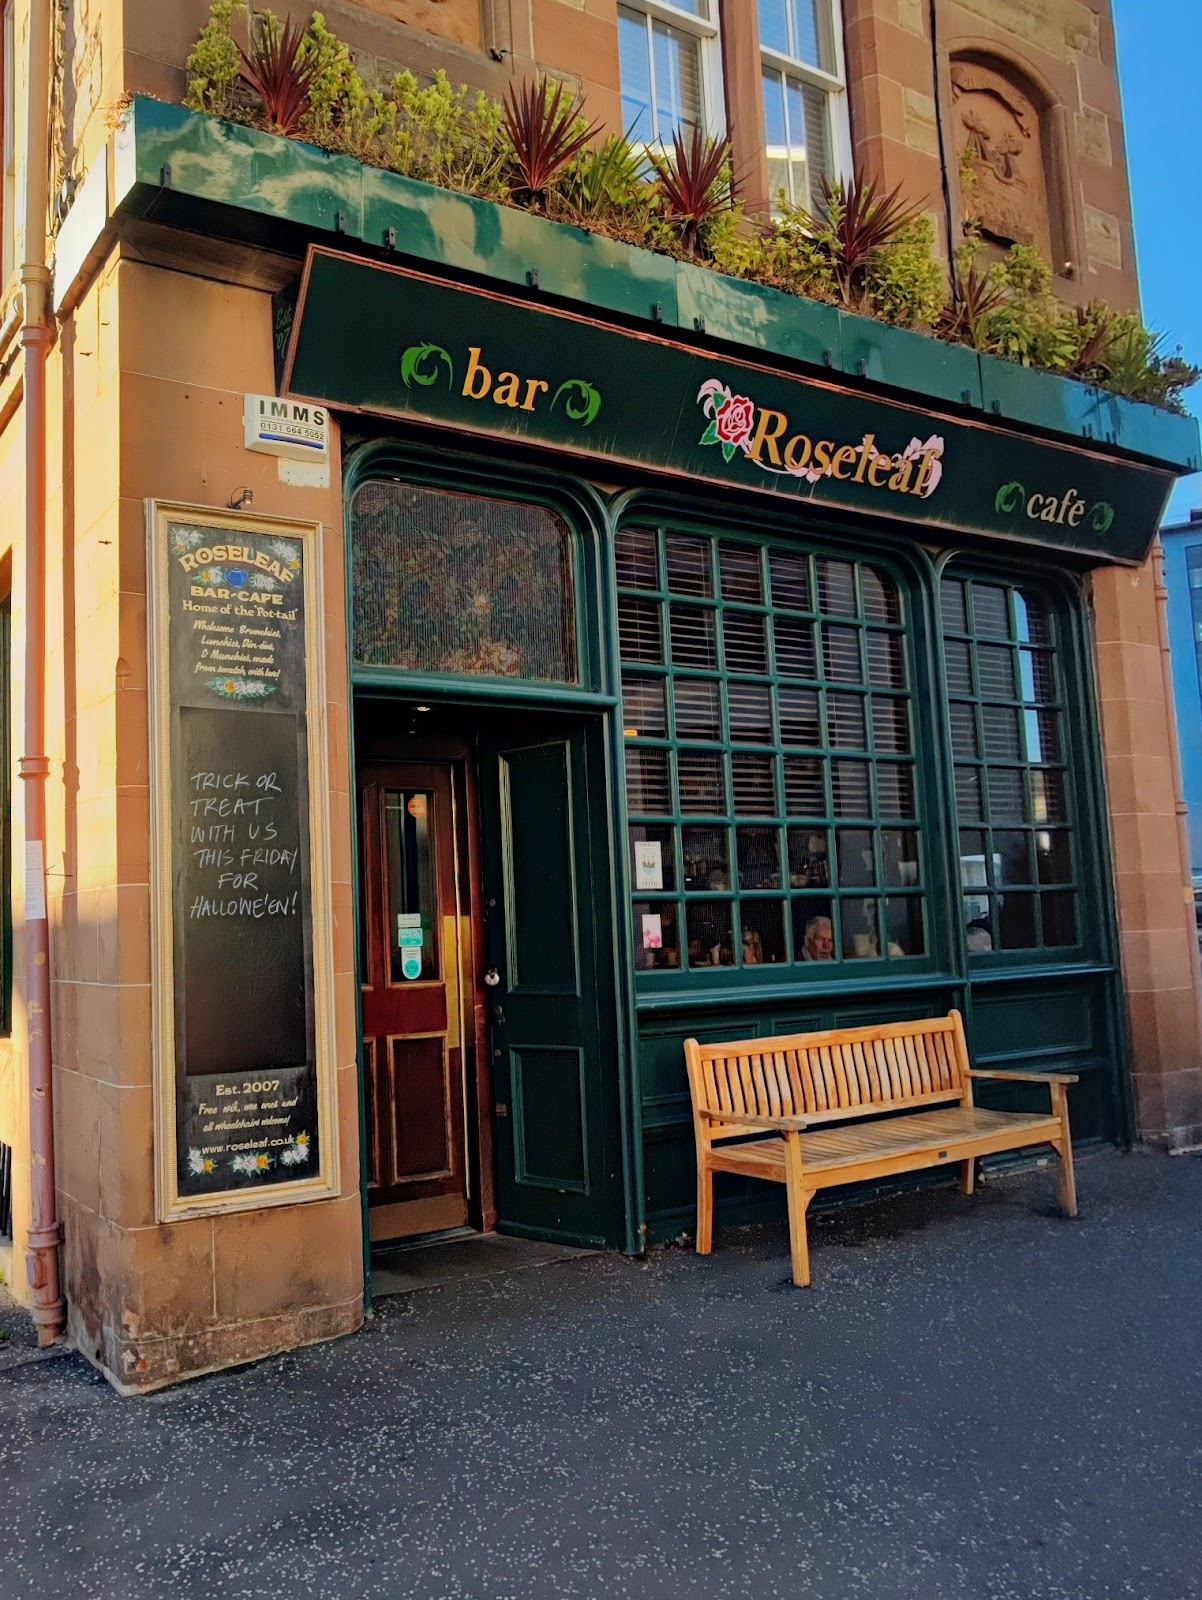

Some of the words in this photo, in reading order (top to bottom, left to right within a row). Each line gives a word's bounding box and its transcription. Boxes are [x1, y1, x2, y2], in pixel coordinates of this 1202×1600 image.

[462, 347, 549, 411] bar
[260, 400, 324, 426] IMMS
[260, 422, 283, 431] 0131
[286, 425, 302, 435] 664
[304, 429, 324, 440] 5052
[744, 407, 941, 496] Roseleaf
[178, 545, 295, 583] ROSELEAF
[190, 585, 284, 605] BAR-CAFE
[182, 600, 218, 613] Home
[220, 604, 232, 614] of
[234, 605, 254, 616] the
[192, 619, 235, 633] Wholesome
[239, 625, 281, 638] Brunchies,
[201, 635, 240, 649] Lunchies,
[210, 649, 251, 663] Munchies,
[253, 655, 275, 664] made
[194, 661, 217, 674] from
[217, 665, 246, 676] scratch,
[248, 667, 264, 676] with
[264, 668, 281, 681] love!
[190, 772, 250, 791] TRICK
[256, 772, 282, 792] OR
[190, 797, 274, 817] TREAT
[191, 825, 235, 843] WITH
[249, 823, 278, 841] US
[193, 849, 234, 868] THIS
[240, 847, 298, 874] FRIDAY
[218, 872, 258, 890] FOR
[190, 891, 298, 919] HALLOWE'EN!
[215, 1084, 241, 1096] Est.
[242, 1080, 280, 1094] 2007
[198, 1103, 218, 1115] Free
[244, 1103, 258, 1111] wee
[261, 1100, 278, 1109] ones
[281, 1096, 298, 1107] and
[203, 1121, 214, 1132] all
[214, 1118, 260, 1130] wheelchairs
[261, 1114, 291, 1126] welcome!
[201, 1134, 295, 1154] www.roseleaf.co.uk
